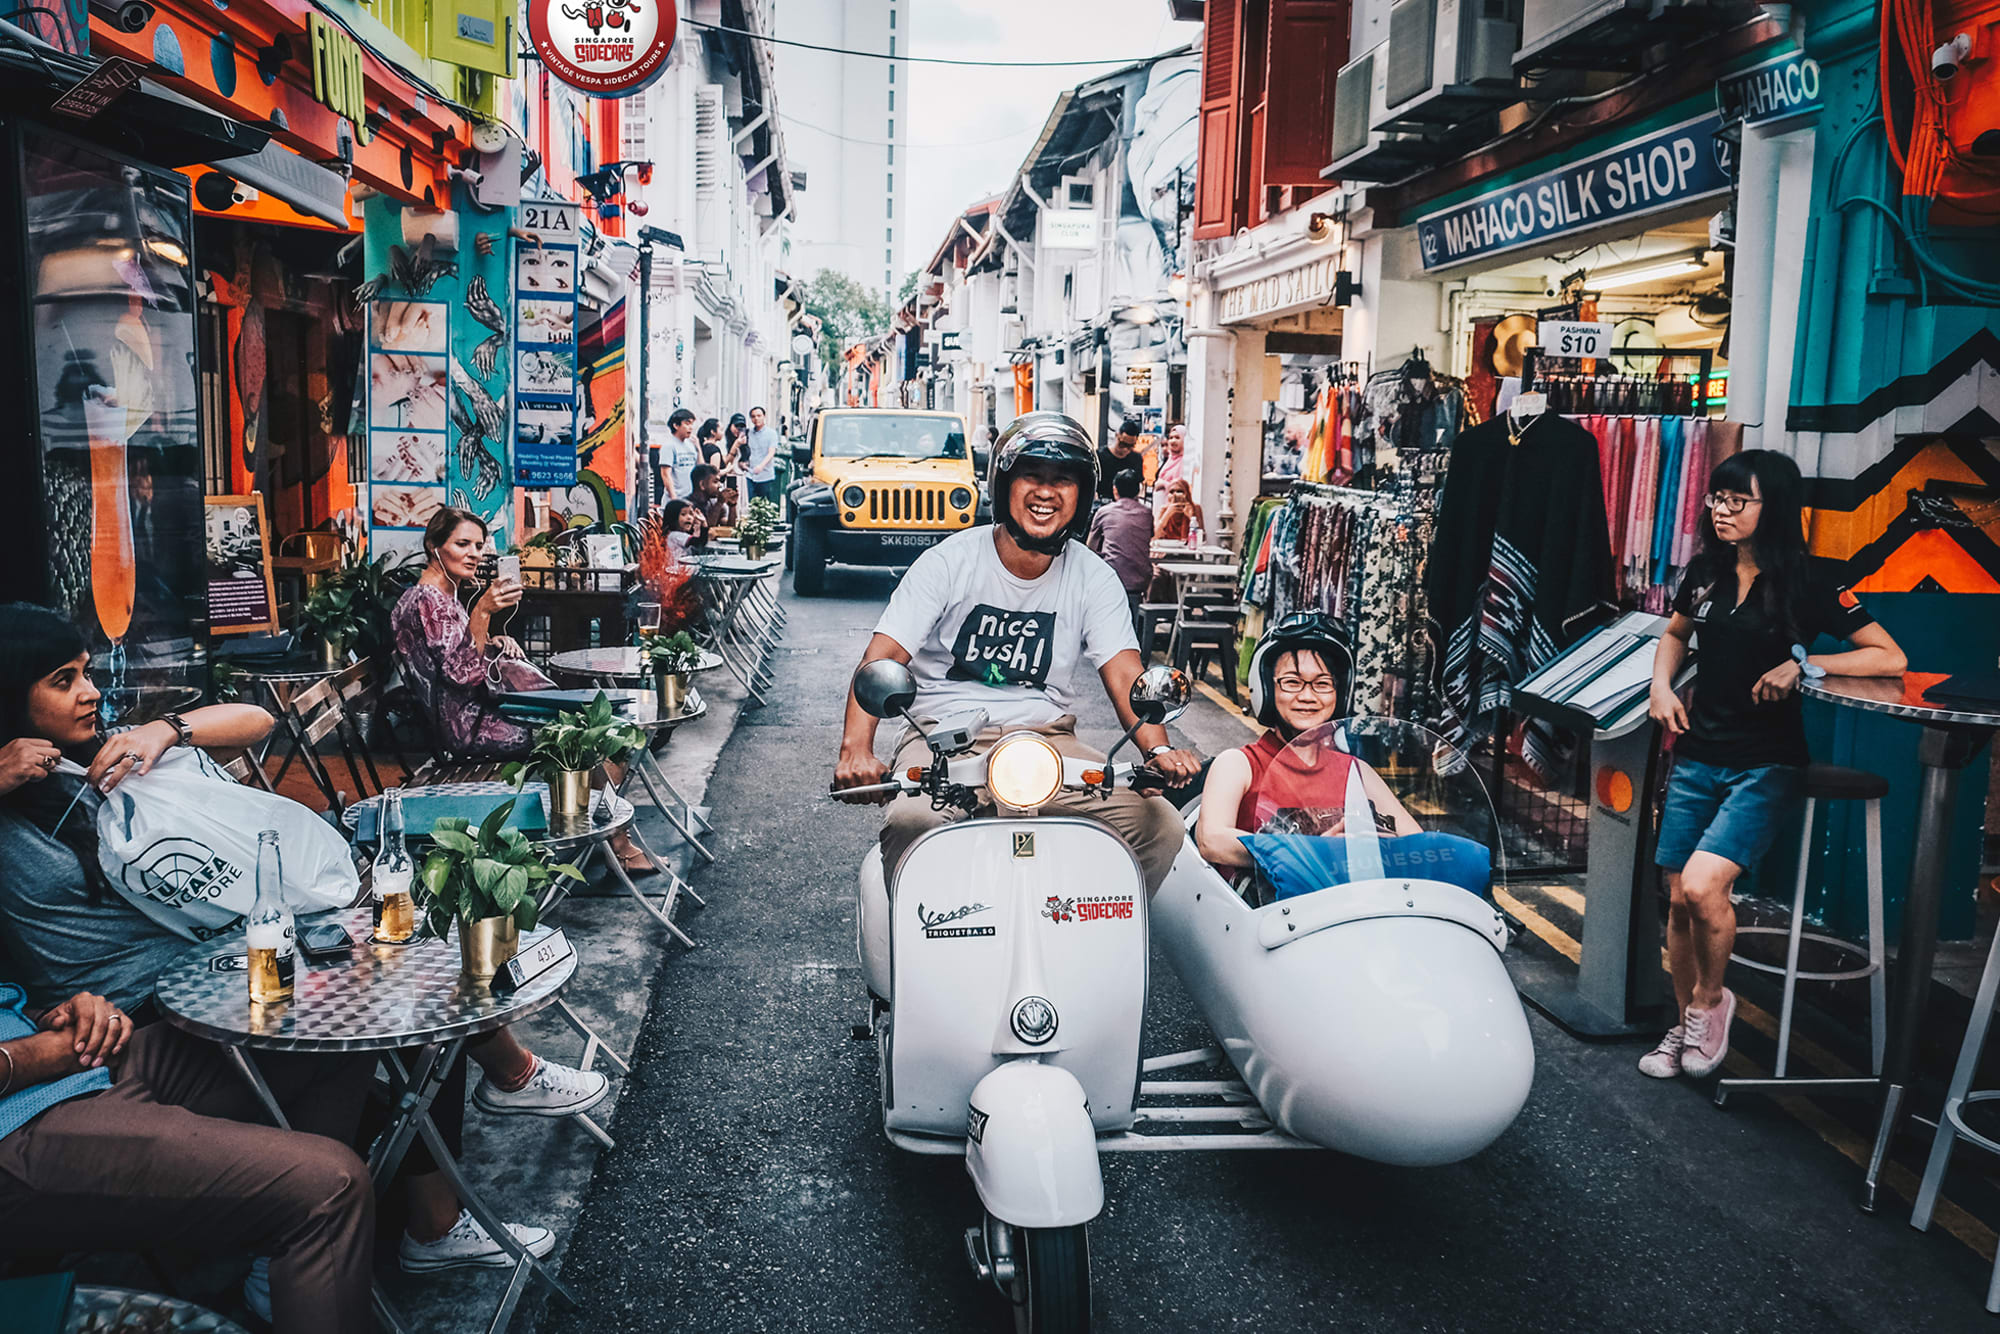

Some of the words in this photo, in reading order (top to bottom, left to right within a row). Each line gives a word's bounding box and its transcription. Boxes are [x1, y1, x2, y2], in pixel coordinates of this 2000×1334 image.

[545, 49, 574, 78] VINTAGE
[575, 74, 601, 85] VESPA
[604, 70, 639, 85] SIDECAR
[640, 49, 661, 72] TOURS
[61, 98, 99, 114] OPERATION
[72, 89, 99, 102] CCTV
[1444, 192, 1535, 256] MAHACO
[1537, 169, 1601, 230] SILK
[1605, 137, 1696, 210] SHOP
[525, 207, 571, 231] 21A
[1220, 285, 1245, 319] THE
[1250, 274, 1280, 313] MAD
[1286, 258, 1337, 304] SAILO
[1560, 326, 1601, 335] PASHMINA
[1560, 335, 1597, 355] $10
[978, 612, 1039, 637] nice
[965, 633, 1045, 676] bush!
[918, 902, 993, 931] Vespa
[928, 928, 994, 937] TRIQUETRA.SG
[537, 944, 556, 963] 431
